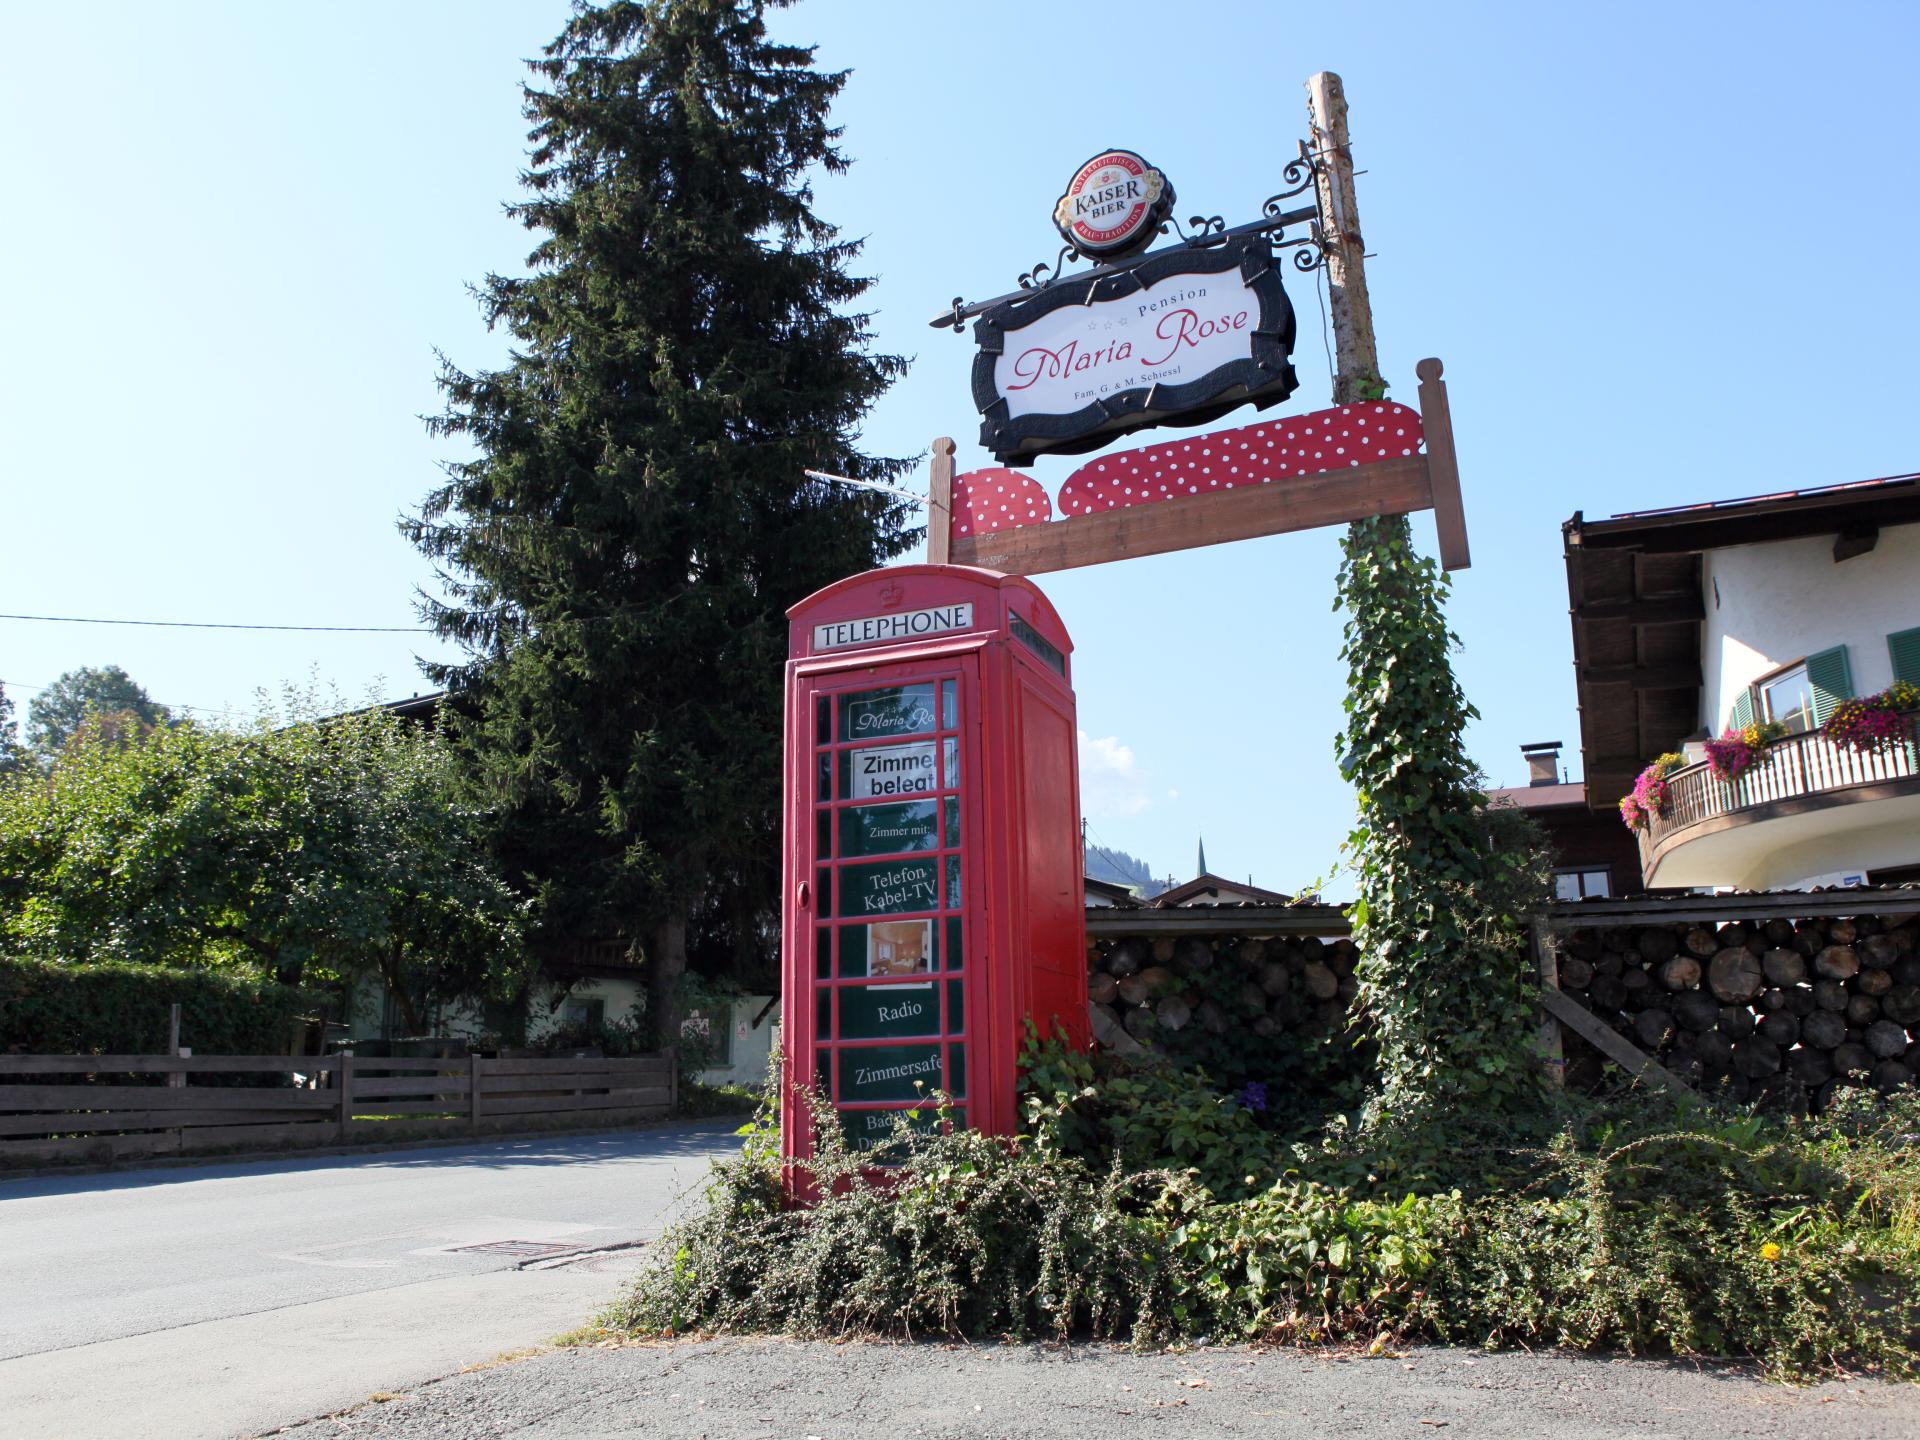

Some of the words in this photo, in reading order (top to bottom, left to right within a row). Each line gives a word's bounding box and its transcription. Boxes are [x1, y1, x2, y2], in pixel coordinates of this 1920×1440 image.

[1076, 180, 1140, 216] KAISER
[1092, 200, 1126, 219] BIER
[1138, 288, 1207, 317] Pension
[1006, 339, 1132, 390] Maria
[1141, 308, 1248, 366] Rose
[1074, 389, 1097, 400] Fam.
[1141, 365, 1181, 383] Schiessl
[822, 606, 967, 646] TELEPHONE
[856, 713, 904, 731] Maria
[906, 708, 946, 730] Ro
[870, 827, 908, 838] Zimmer
[911, 825, 931, 836] mit:
[869, 867, 926, 890] Telefon
[864, 879, 935, 911] Kabel-TV
[878, 1001, 922, 1023] Radio
[855, 1054, 943, 1085] Zimmersafe
